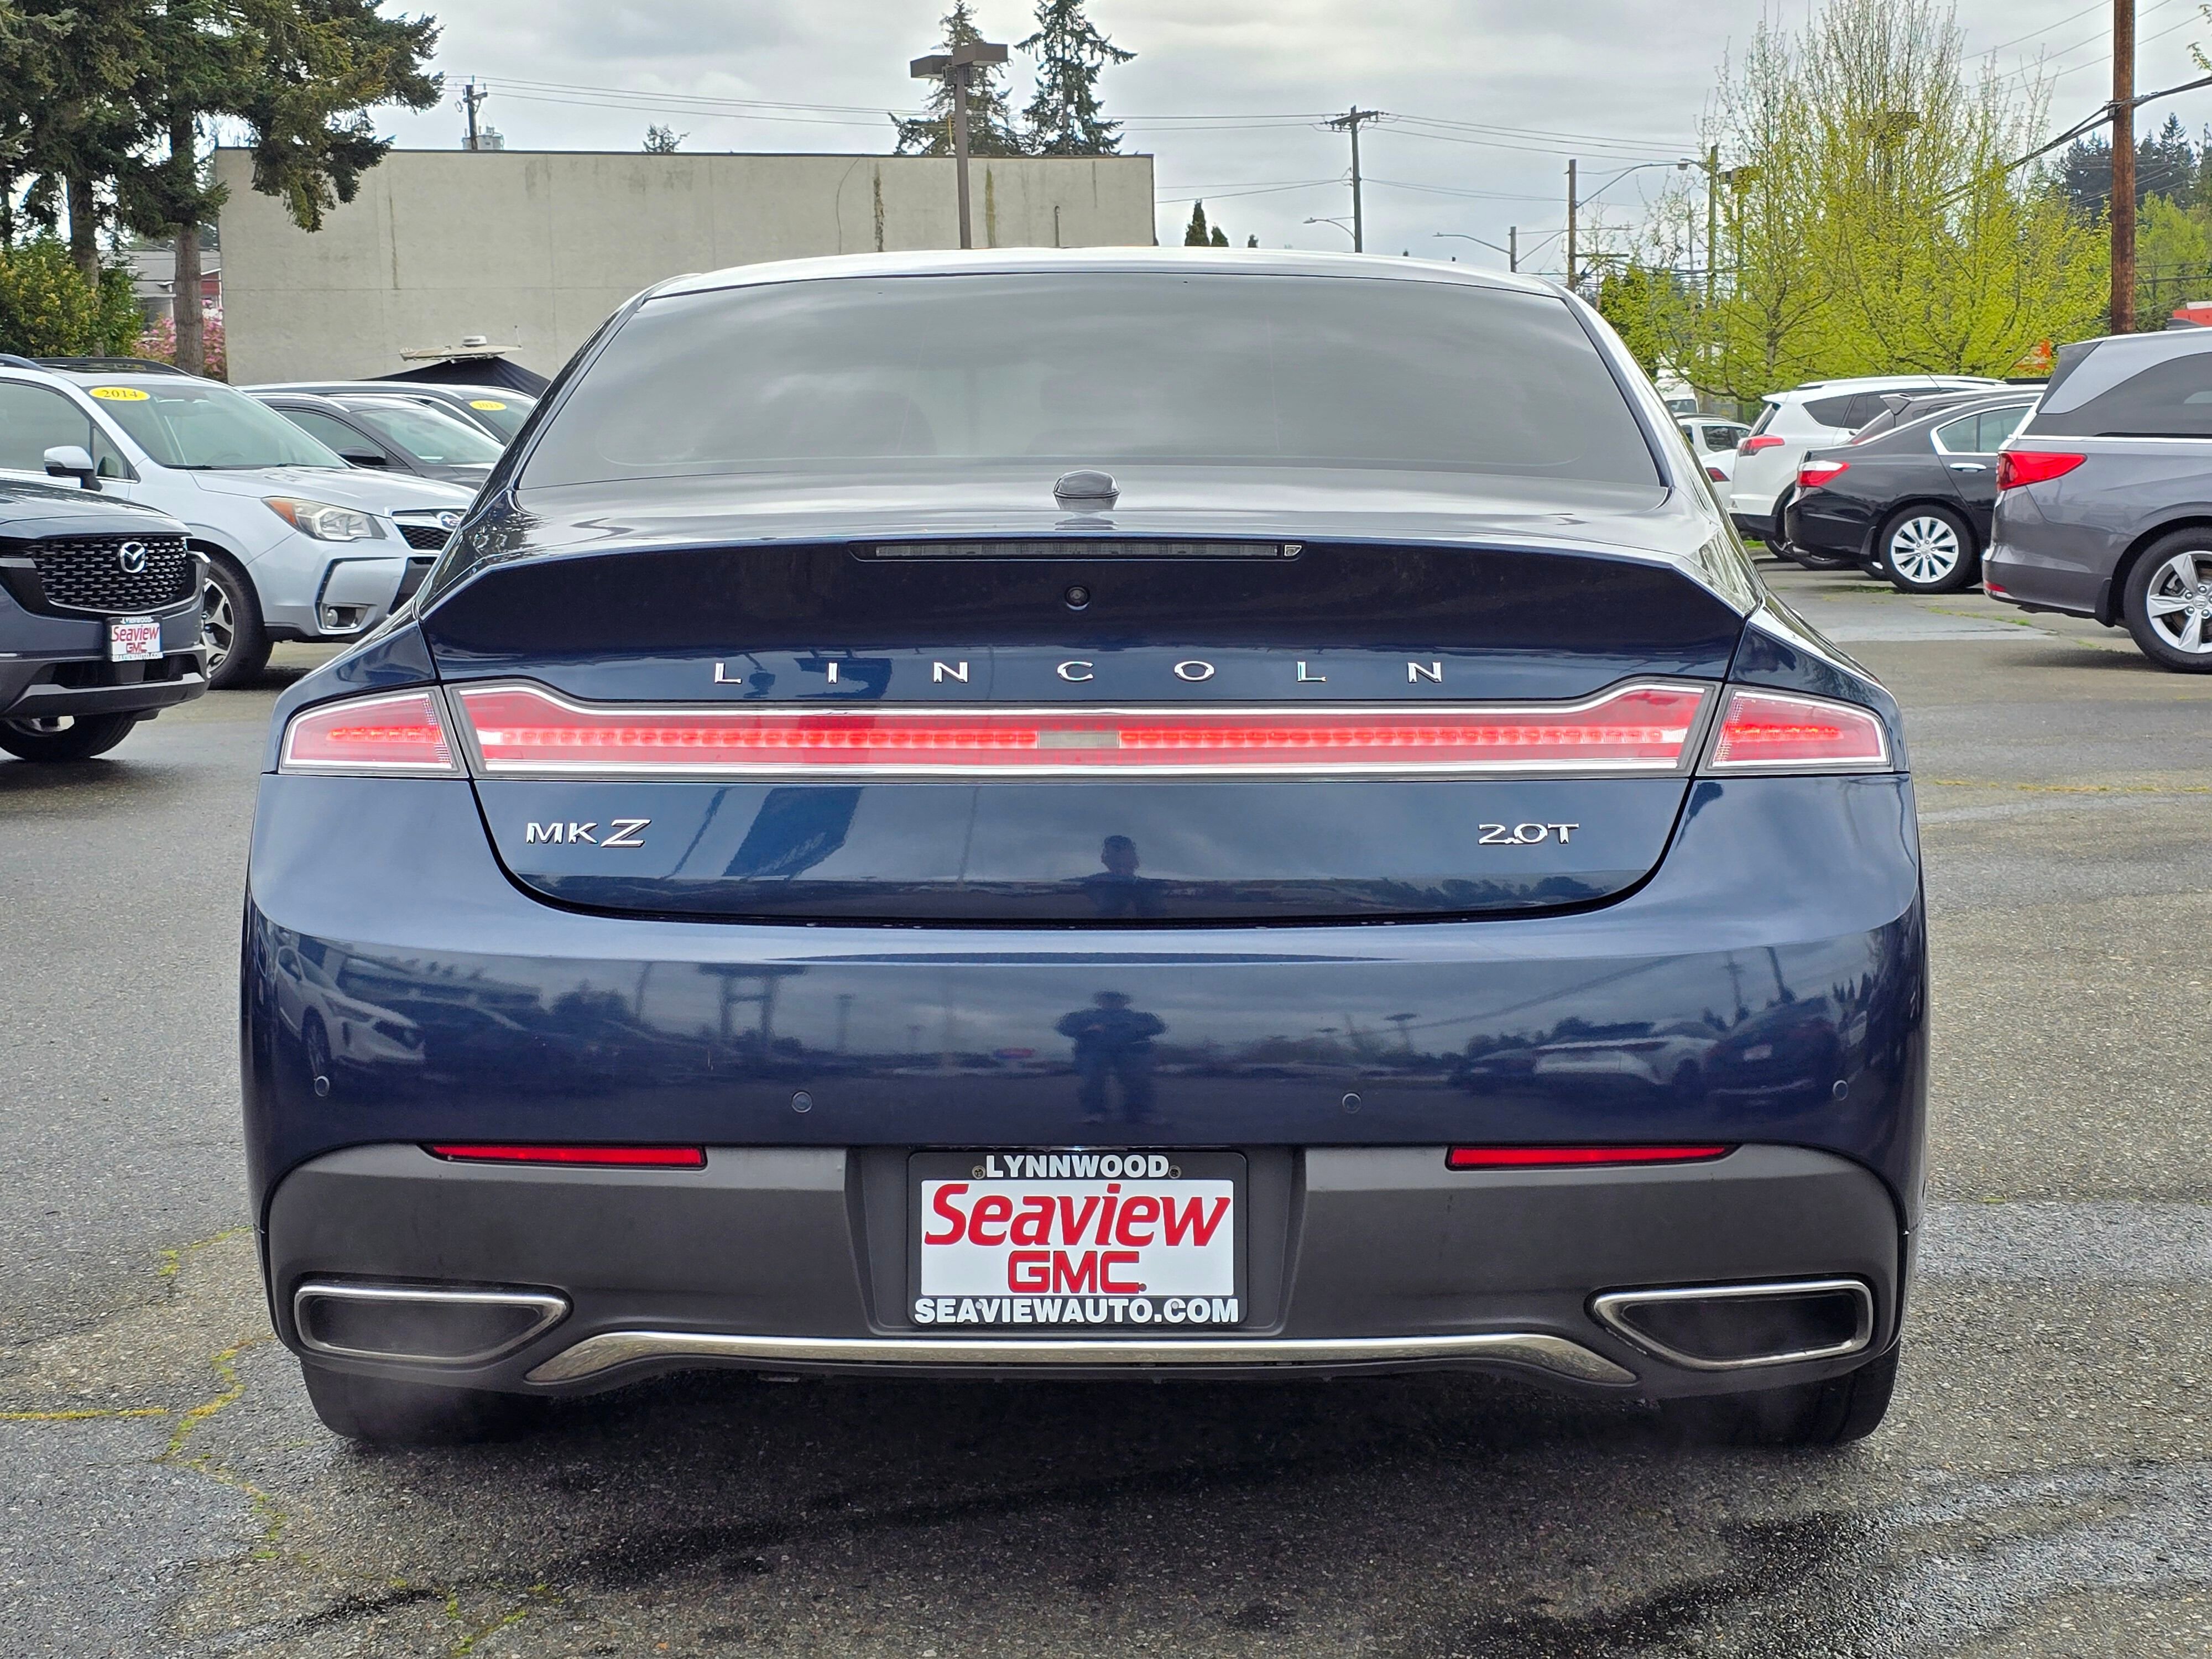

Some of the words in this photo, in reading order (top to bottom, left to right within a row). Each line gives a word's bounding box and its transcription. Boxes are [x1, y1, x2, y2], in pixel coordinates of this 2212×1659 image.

[111, 625, 159, 642] Seaview
[126, 641, 147, 654] GMC
[713, 660, 1443, 685] LINCOLN
[985, 1154, 1170, 1178] LYNNWOOD
[924, 1183, 1231, 1246] Seaview
[1008, 1250, 1140, 1294] GMC
[914, 1297, 1239, 1323] SEAVIEWAUTO.COM
